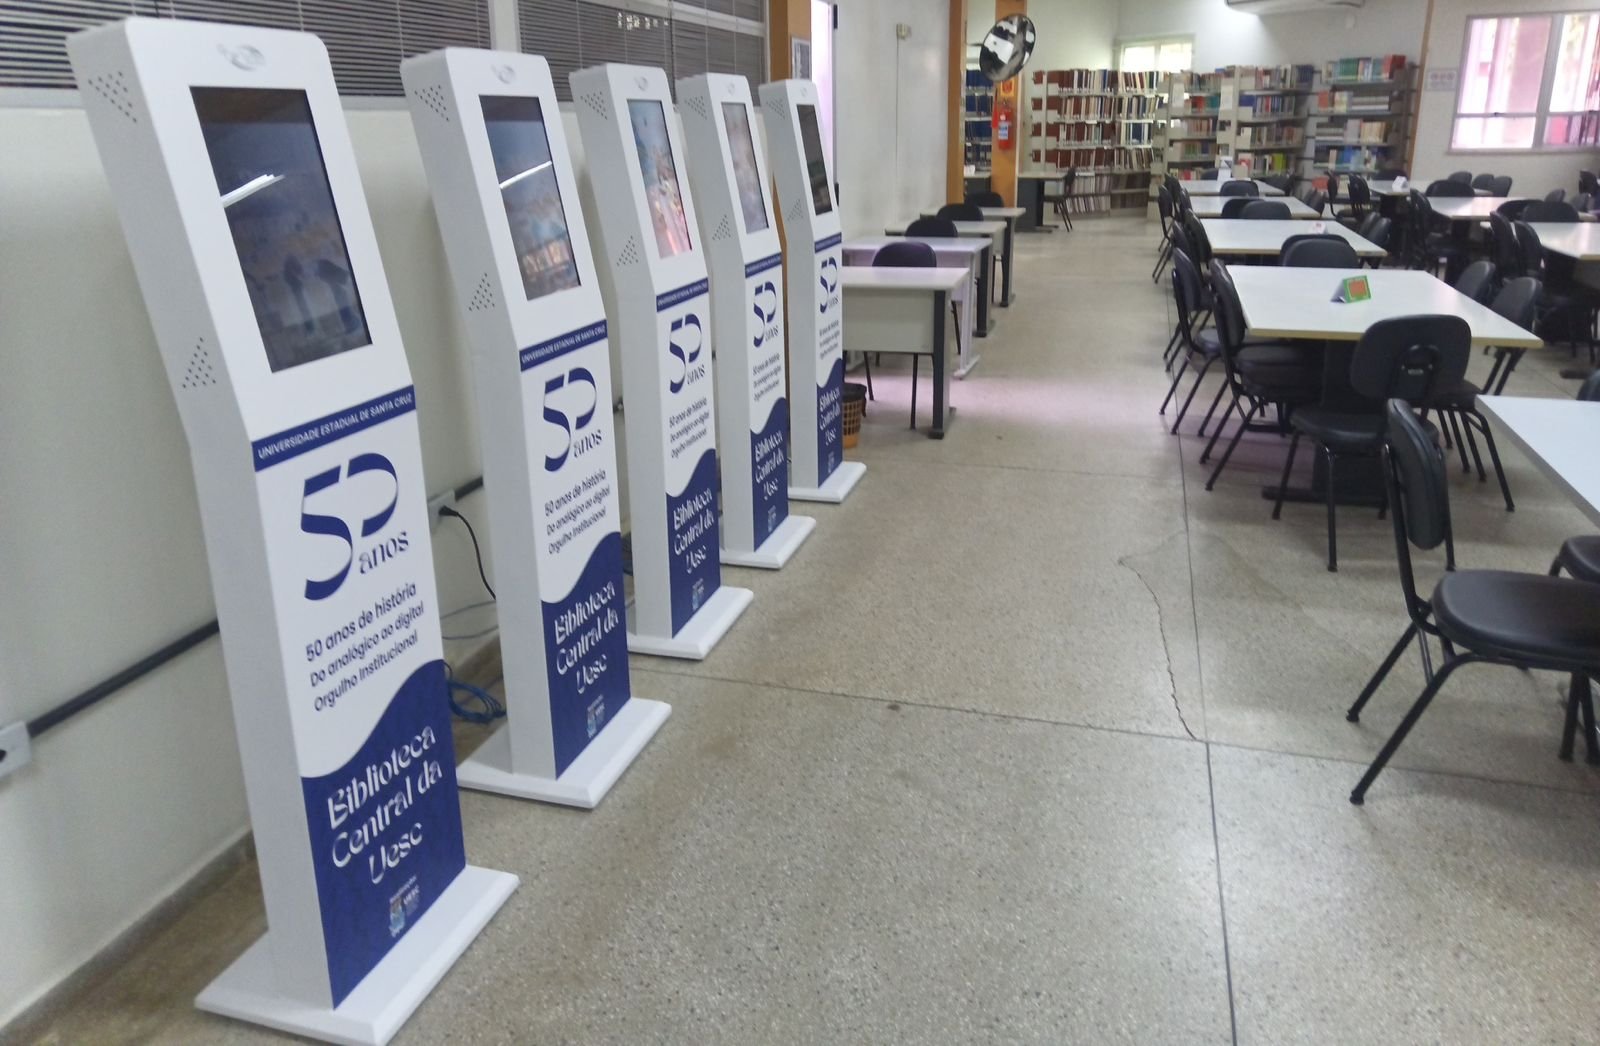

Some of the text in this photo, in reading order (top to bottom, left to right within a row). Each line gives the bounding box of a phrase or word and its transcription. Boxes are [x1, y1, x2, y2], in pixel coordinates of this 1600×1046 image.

[258, 393, 412, 459] UNIVERSIDADE ESTADUAL DE SANTA CRUZ
[573, 429, 602, 459] anos
[673, 487, 713, 531] Biblioteca
[674, 508, 714, 556] Central da
[358, 531, 409, 575] anos
[305, 582, 416, 662] 50 anos de história
[310, 600, 424, 687] Do analógico ao digital
[554, 580, 615, 645] Biblioteca
[556, 607, 619, 675] Central da
[314, 629, 418, 712] Orgulho Institucional
[576, 653, 607, 694] Uesc
[327, 726, 436, 830] Biblioteca
[332, 760, 442, 868] Central da
[368, 822, 423, 885] Uesc
